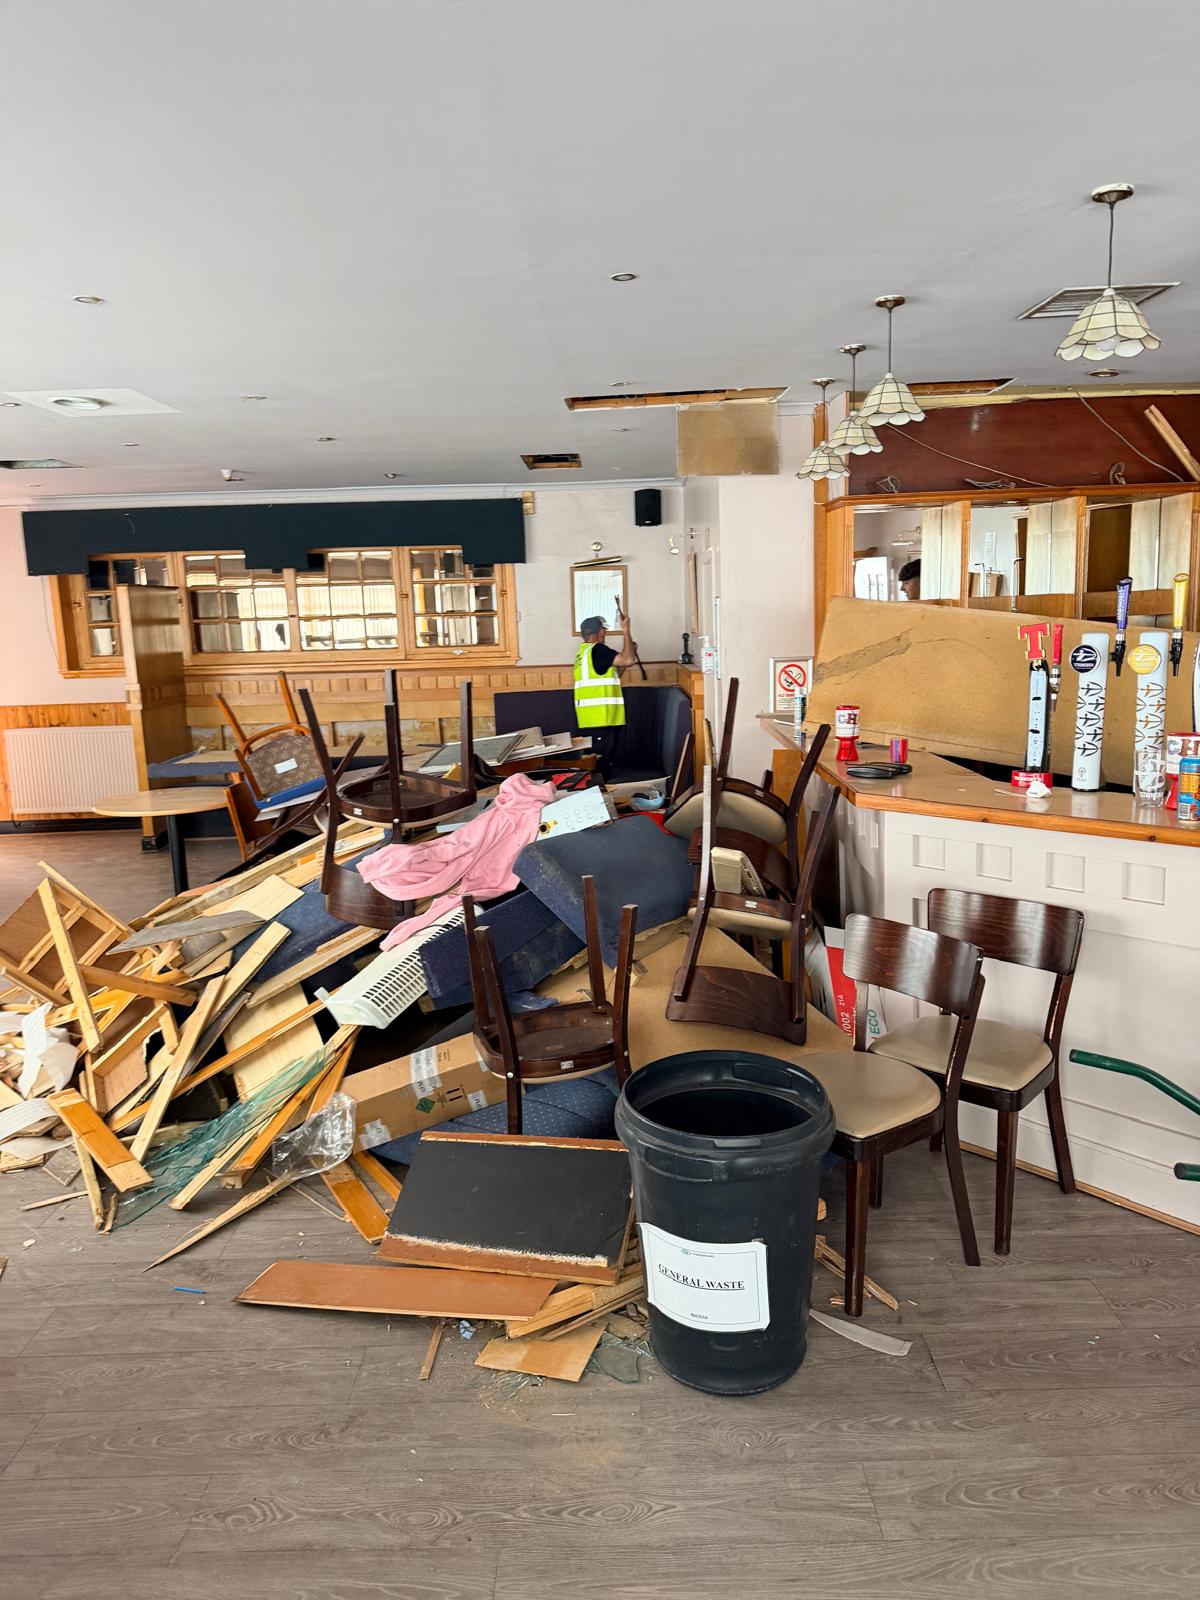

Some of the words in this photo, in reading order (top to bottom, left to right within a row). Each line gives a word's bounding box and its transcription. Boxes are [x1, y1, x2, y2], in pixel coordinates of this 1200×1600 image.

[867, 1009, 880, 1034] ECO
[658, 1263, 704, 1288] GENERAL
[706, 1280, 745, 1289] WASTE
